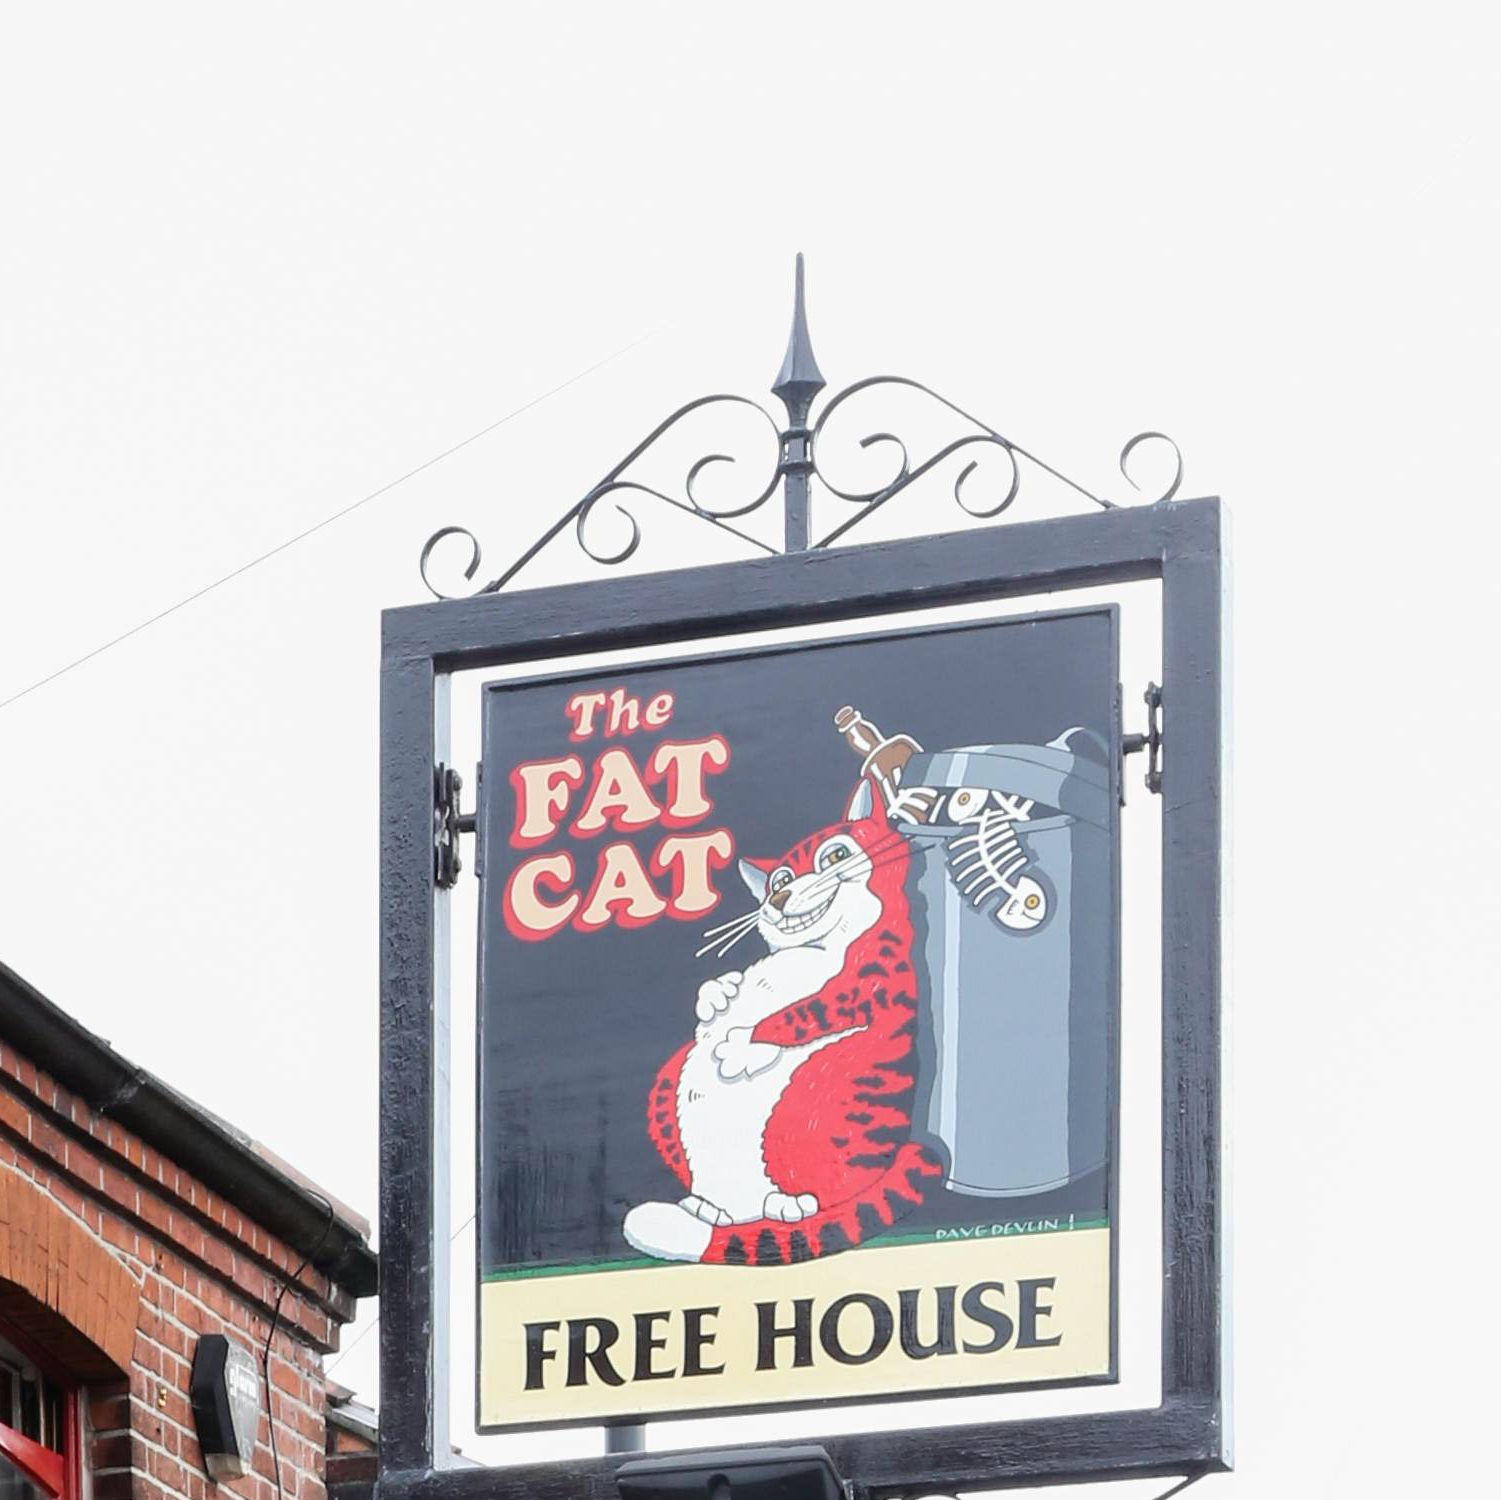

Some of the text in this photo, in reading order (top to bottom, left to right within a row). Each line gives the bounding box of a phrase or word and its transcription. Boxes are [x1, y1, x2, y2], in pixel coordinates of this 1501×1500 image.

[566, 686, 674, 741] The
[509, 736, 731, 849] FAT
[502, 829, 736, 941] CAT
[935, 1224, 988, 1240] DAVE
[522, 1277, 1062, 1392] FREE HOUSE
